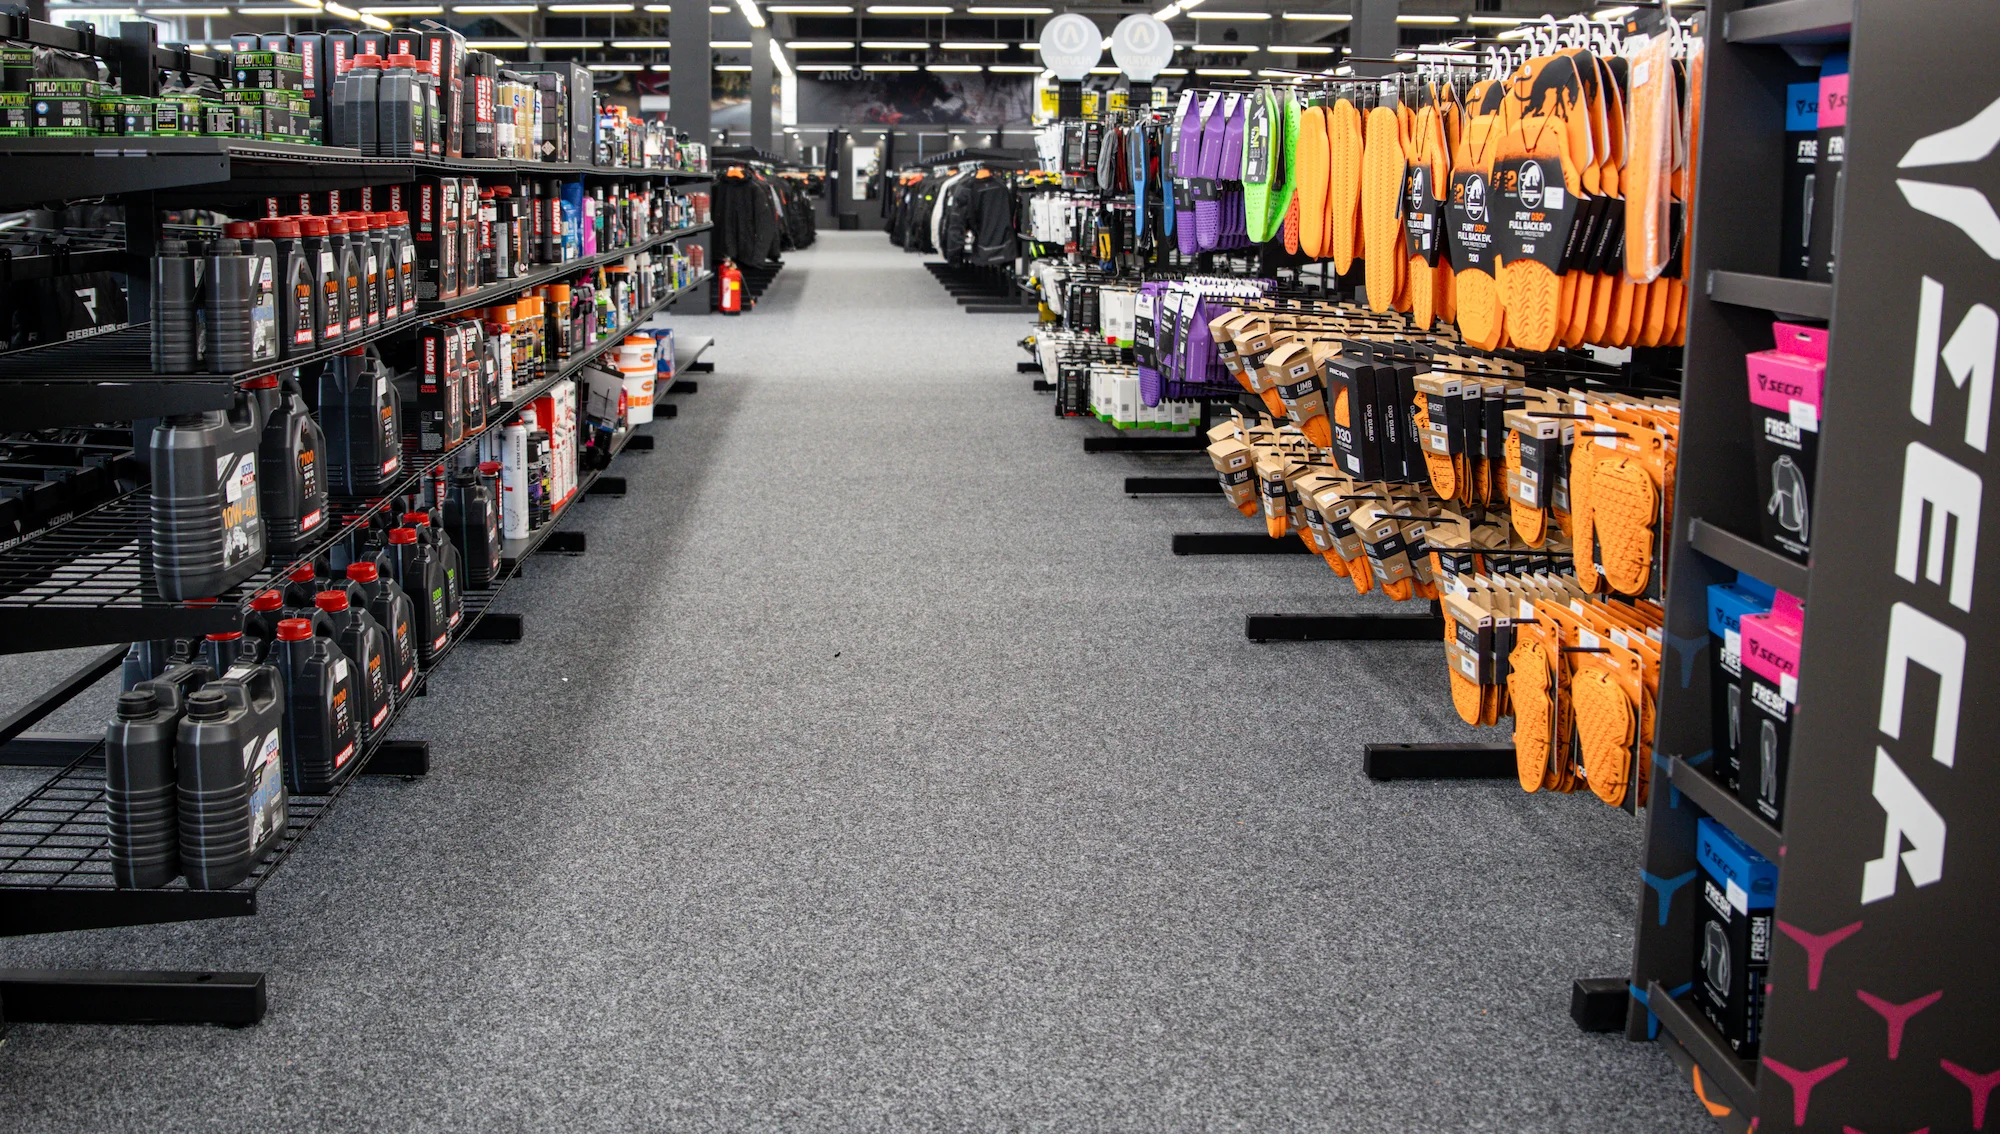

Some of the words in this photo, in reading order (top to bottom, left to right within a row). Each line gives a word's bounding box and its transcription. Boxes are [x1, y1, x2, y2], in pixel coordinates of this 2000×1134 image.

[236, 55, 272, 64] HIFLOFILTRO
[304, 43, 313, 77] MOTUL
[431, 41, 441, 75] MOTUL
[819, 69, 875, 80] AIROH
[35, 82, 81, 92] HIFLOFILTRO
[224, 92, 261, 101] HIFLOFILTRO
[477, 79, 487, 120] MOTUL
[62, 118, 81, 126] HF303
[1797, 139, 1819, 157] FRE
[1507, 170, 1517, 191] 2
[1456, 183, 1464, 203] 2
[422, 186, 431, 221] MOTUL
[553, 200, 561, 233] MOTUL
[1515, 211, 1531, 220] FURY
[1462, 223, 1474, 232] FURY
[1508, 220, 1523, 229] FULL
[1523, 221, 1539, 231] BACK
[1539, 222, 1552, 232] EVO
[1458, 231, 1469, 240] FULL
[1469, 232, 1482, 242] BACK
[66, 324, 116, 341] REBELHORN
[425, 338, 435, 373] MOTUL
[1257, 352, 1269, 363] LIM
[1329, 367, 1350, 379] RICHA
[1296, 379, 1313, 393] LIMB
[1768, 380, 1804, 397] SECA
[1367, 419, 1375, 442] DIABLO
[1388, 420, 1396, 443] DIABLO
[1764, 417, 1801, 443] FRESH
[301, 450, 315, 466] 7100
[1233, 470, 1248, 481] LIMB
[222, 495, 257, 530] 10W-40
[1861, 274, 1999, 906] SECA
[369, 654, 380, 673] 7100
[1720, 648, 1742, 672] FRES
[1759, 648, 1795, 673] SECA
[333, 688, 347, 708] 7100
[1751, 681, 1788, 716] FRESH
[250, 773, 281, 816] 15W-50
[1710, 851, 1738, 881] SECA
[1705, 880, 1732, 917] FRESH
[1751, 916, 1766, 960] FRESH
